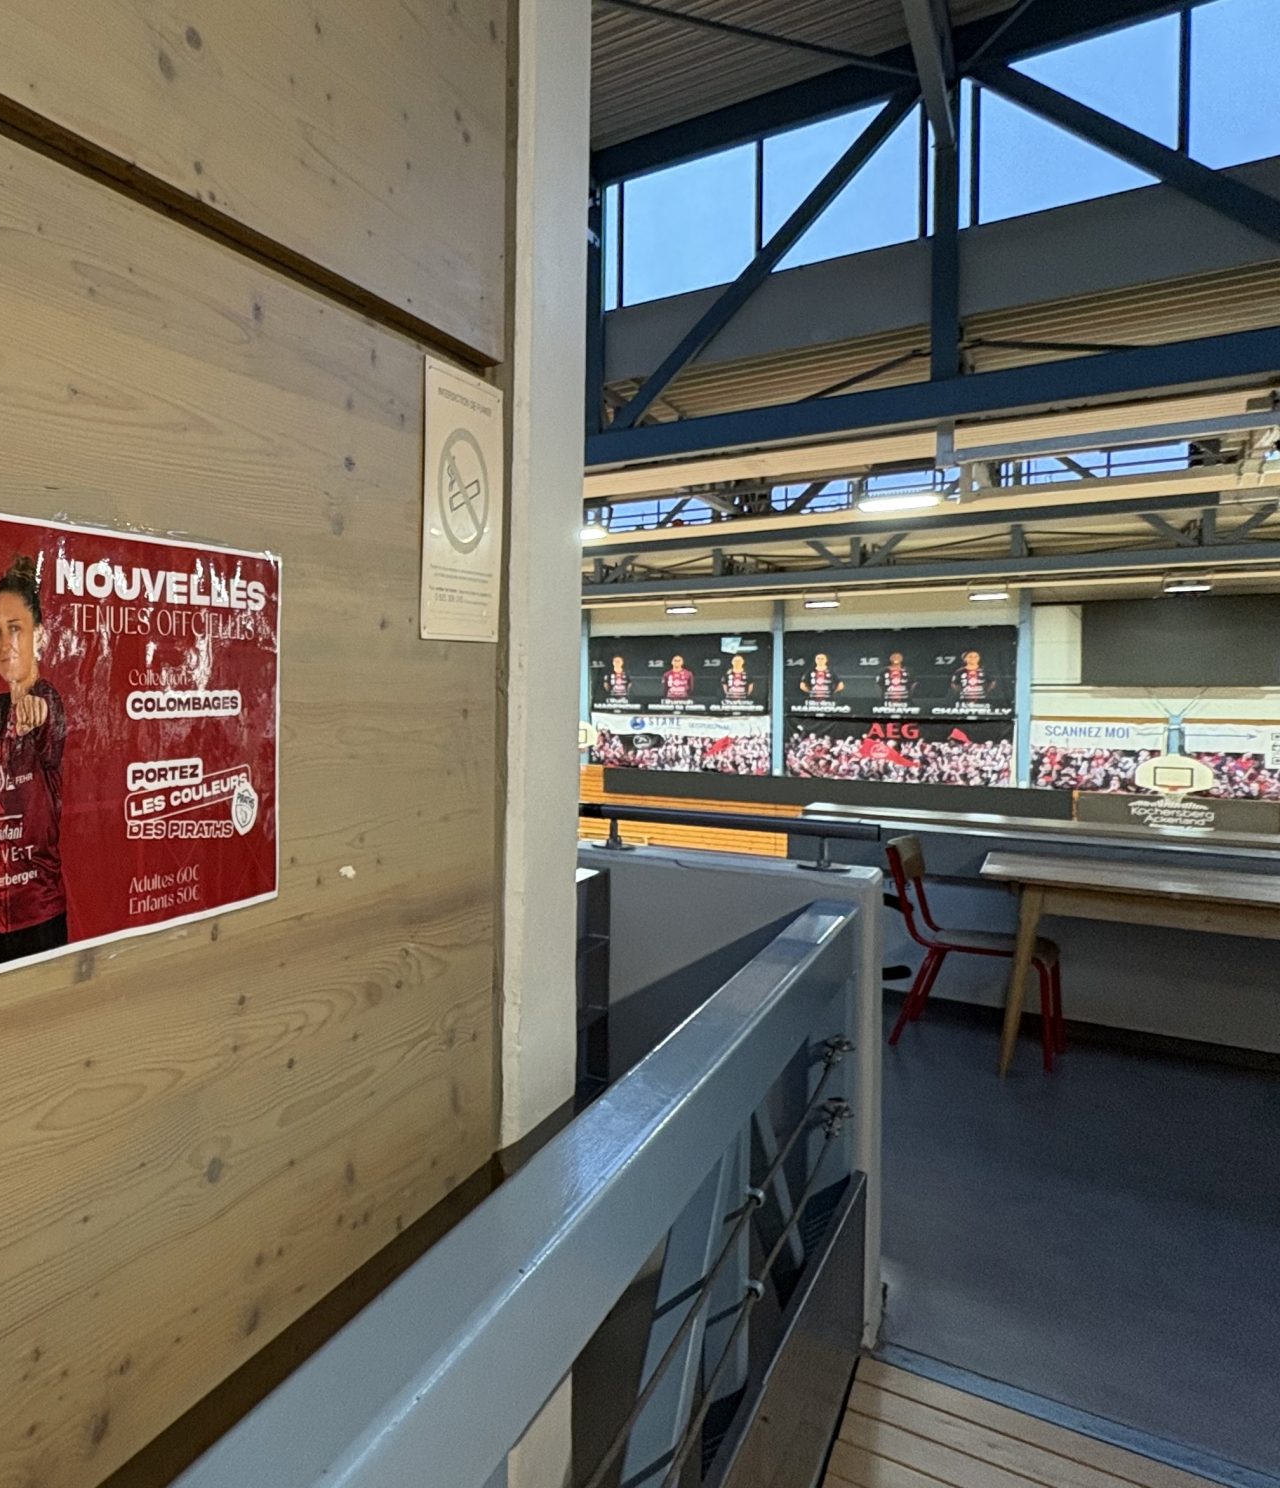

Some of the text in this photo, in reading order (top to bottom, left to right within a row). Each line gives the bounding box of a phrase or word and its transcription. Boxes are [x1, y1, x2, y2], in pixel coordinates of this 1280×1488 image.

[56, 559, 266, 611] NOUVELLES
[71, 602, 150, 635] TENUES
[131, 696, 239, 714] COLOMBAGES
[868, 722, 920, 739] AEG
[1045, 725, 1130, 739] SCANNEZ MOI
[132, 764, 200, 785] PORTEZ
[130, 773, 248, 817] LES COULEURS
[1130, 806, 1215, 822] Kochersberg
[128, 820, 234, 839] DES PIRATHS
[129, 864, 200, 894] Adultes 60€
[129, 884, 200, 915] Enfants 50€
